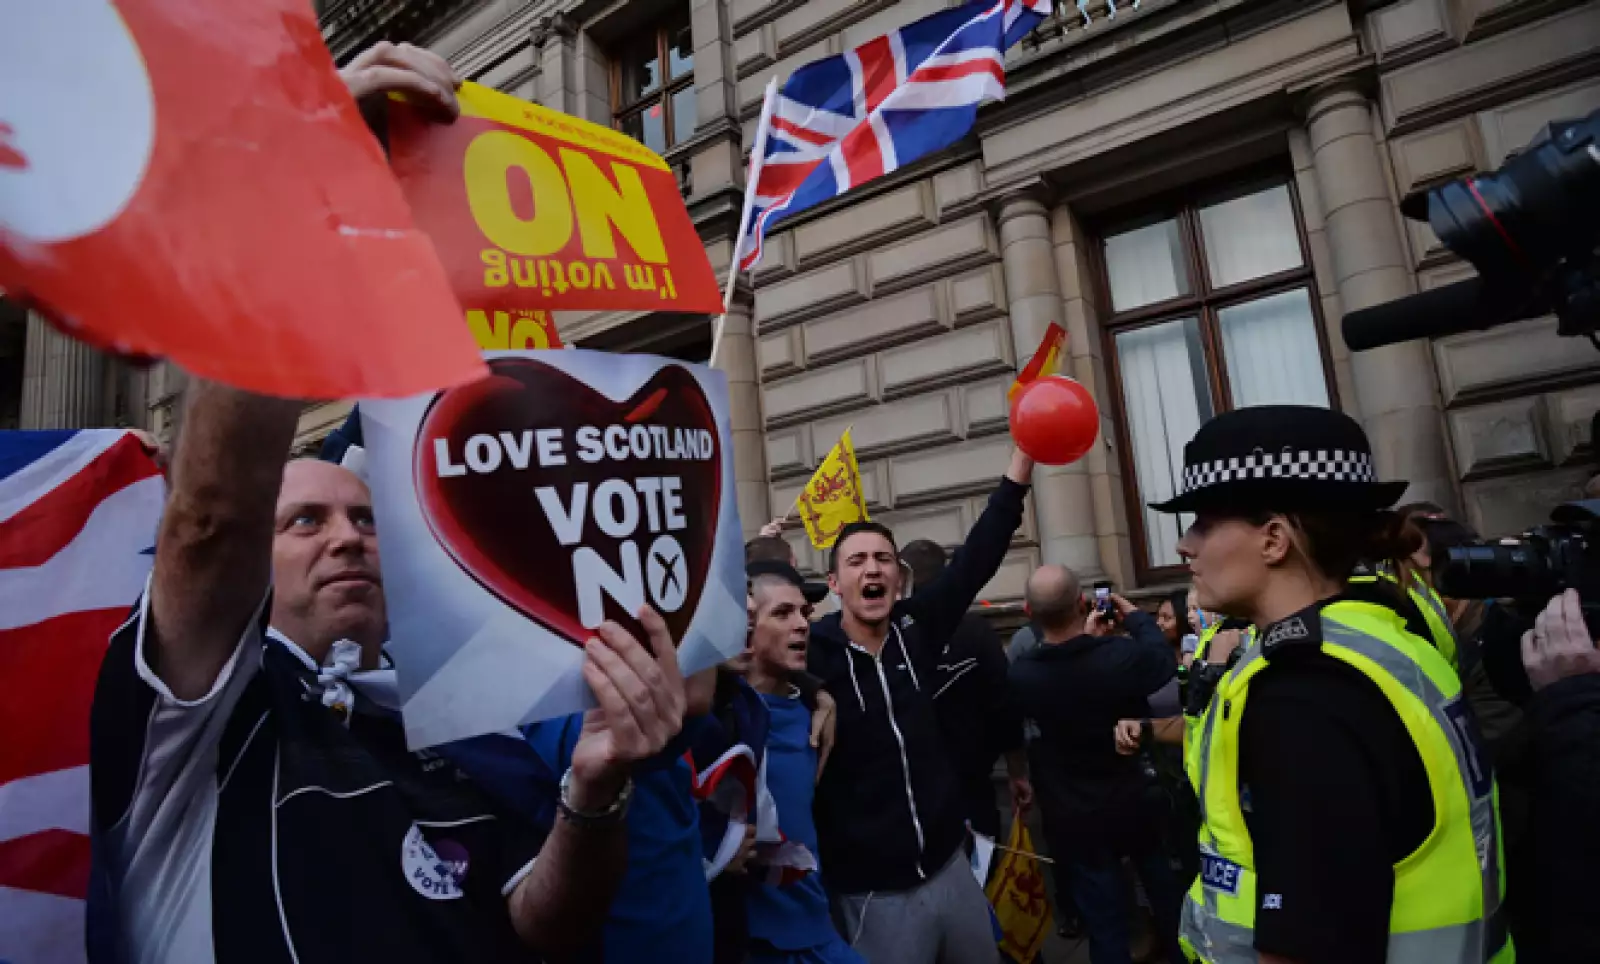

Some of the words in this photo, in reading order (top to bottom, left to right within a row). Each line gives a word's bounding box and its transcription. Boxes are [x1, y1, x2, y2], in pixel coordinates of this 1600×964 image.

[464, 130, 669, 264] NO
[480, 249, 616, 298] voting
[624, 263, 678, 300] I'm
[434, 427, 568, 478] LOVE
[575, 424, 713, 464] SCOTLAND
[534, 476, 688, 546] VOTE
[571, 534, 689, 630] NO
[413, 866, 450, 895] VOTE
